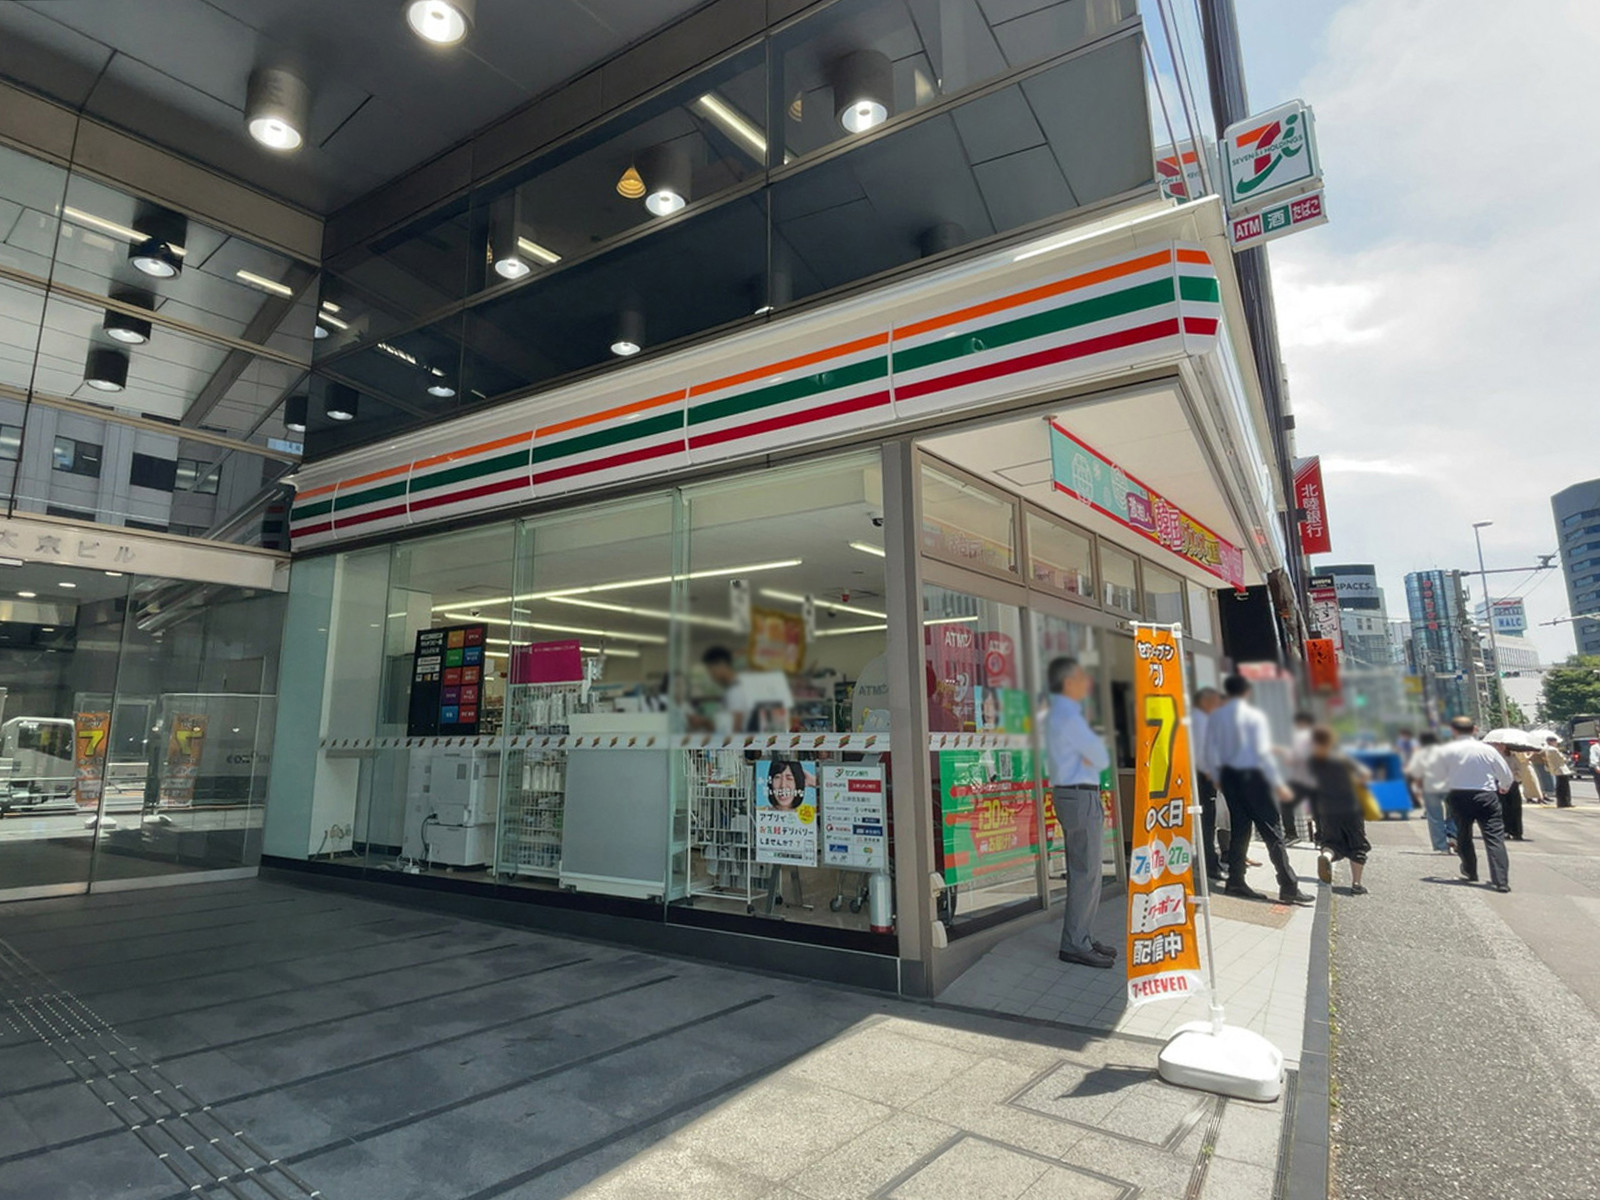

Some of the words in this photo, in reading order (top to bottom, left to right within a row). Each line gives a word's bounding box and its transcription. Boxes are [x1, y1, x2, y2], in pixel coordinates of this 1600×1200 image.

[1292, 199, 1321, 220] たばこ
[1235, 217, 1261, 239] ATM
[1267, 211, 1285, 230] 酒
[1145, 696, 1178, 796] 7
[1168, 846, 1190, 866] 27日
[1132, 933, 1184, 967] 配信中
